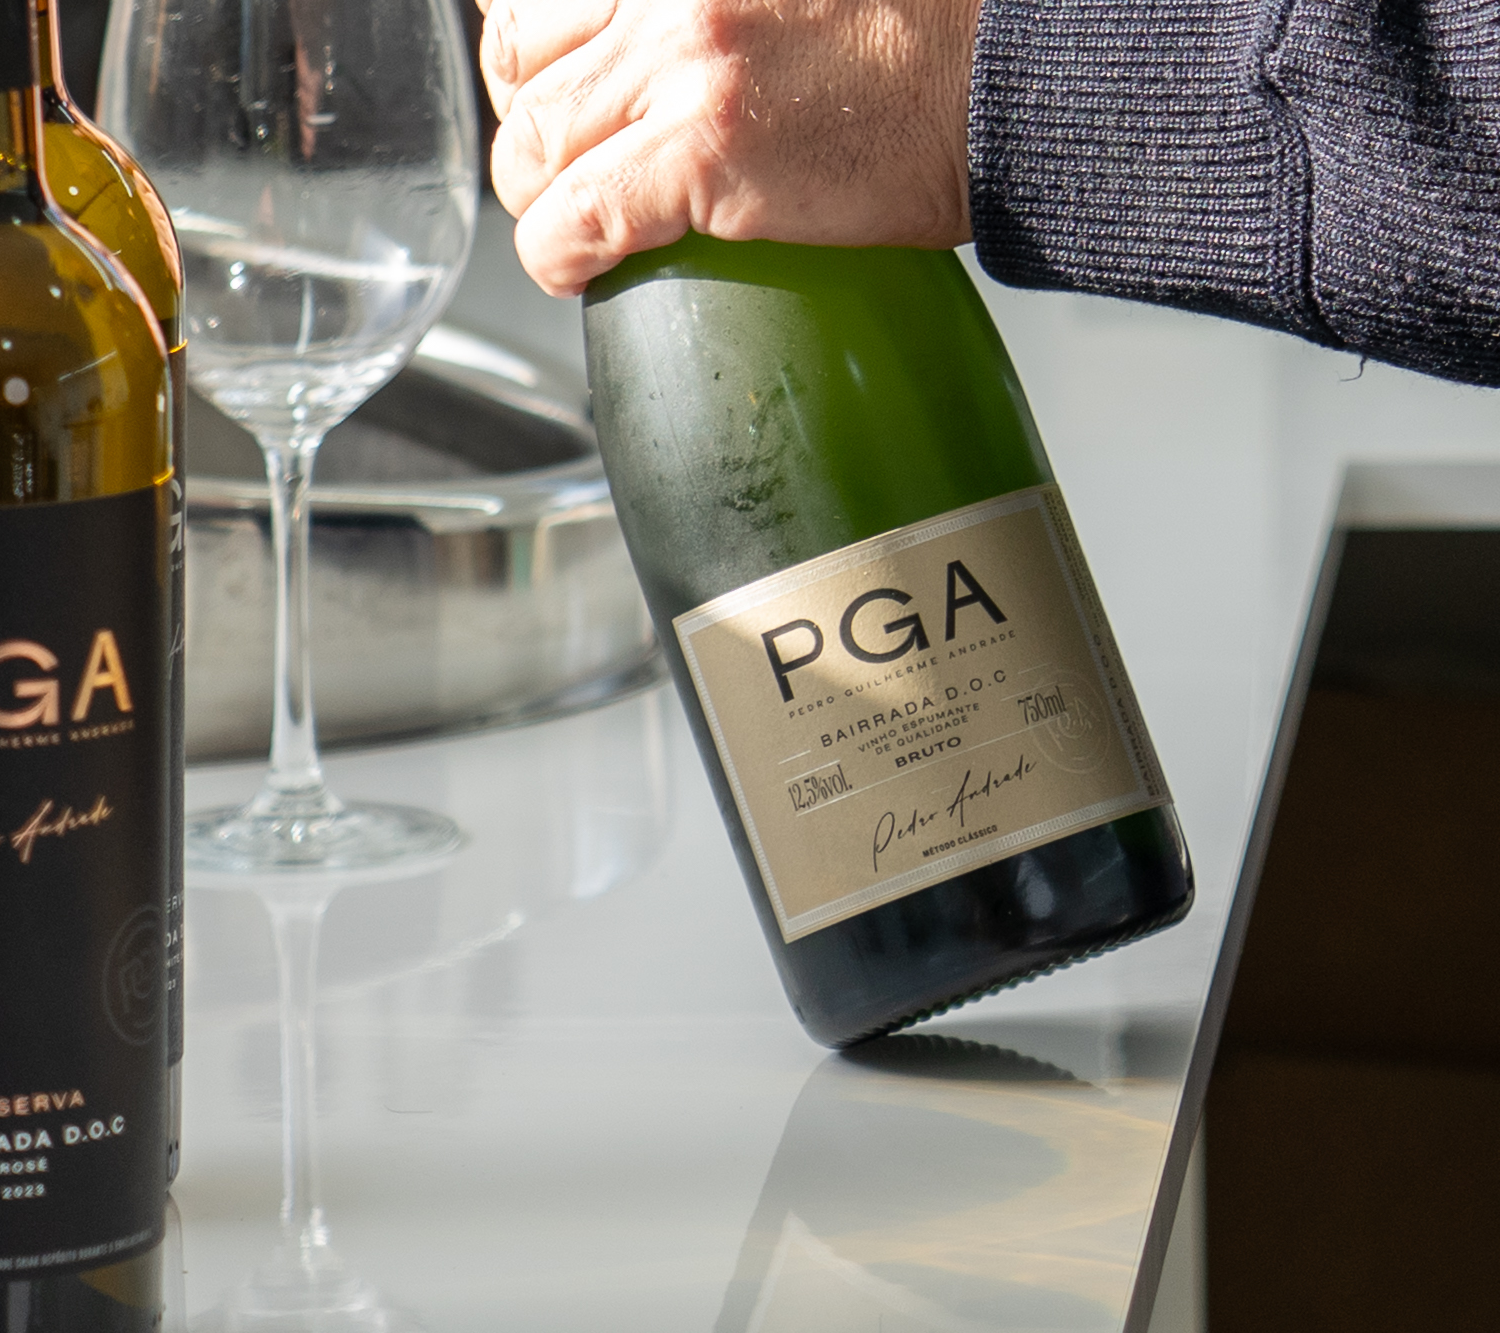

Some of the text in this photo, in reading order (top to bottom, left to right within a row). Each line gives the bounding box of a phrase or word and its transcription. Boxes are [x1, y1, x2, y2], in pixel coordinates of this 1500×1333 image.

[760, 559, 1007, 702] PGA
[788, 629, 1015, 719] PEDRO GUILHERME ANDRADE
[820, 669, 1006, 747] BAIRRADA D.O.C
[1016, 685, 1067, 725] 750ml
[857, 702, 979, 752] VINHO ESPUMANTE
[872, 714, 968, 755] DE QUALIDADE
[894, 736, 961, 768] BRUTO
[872, 754, 1036, 872] Pedro Andrade
[922, 824, 997, 857] MÉTODO CLÁSSICO
[62, 1115, 126, 1146] D.O.C
[2, 1183, 47, 1201] 2023
